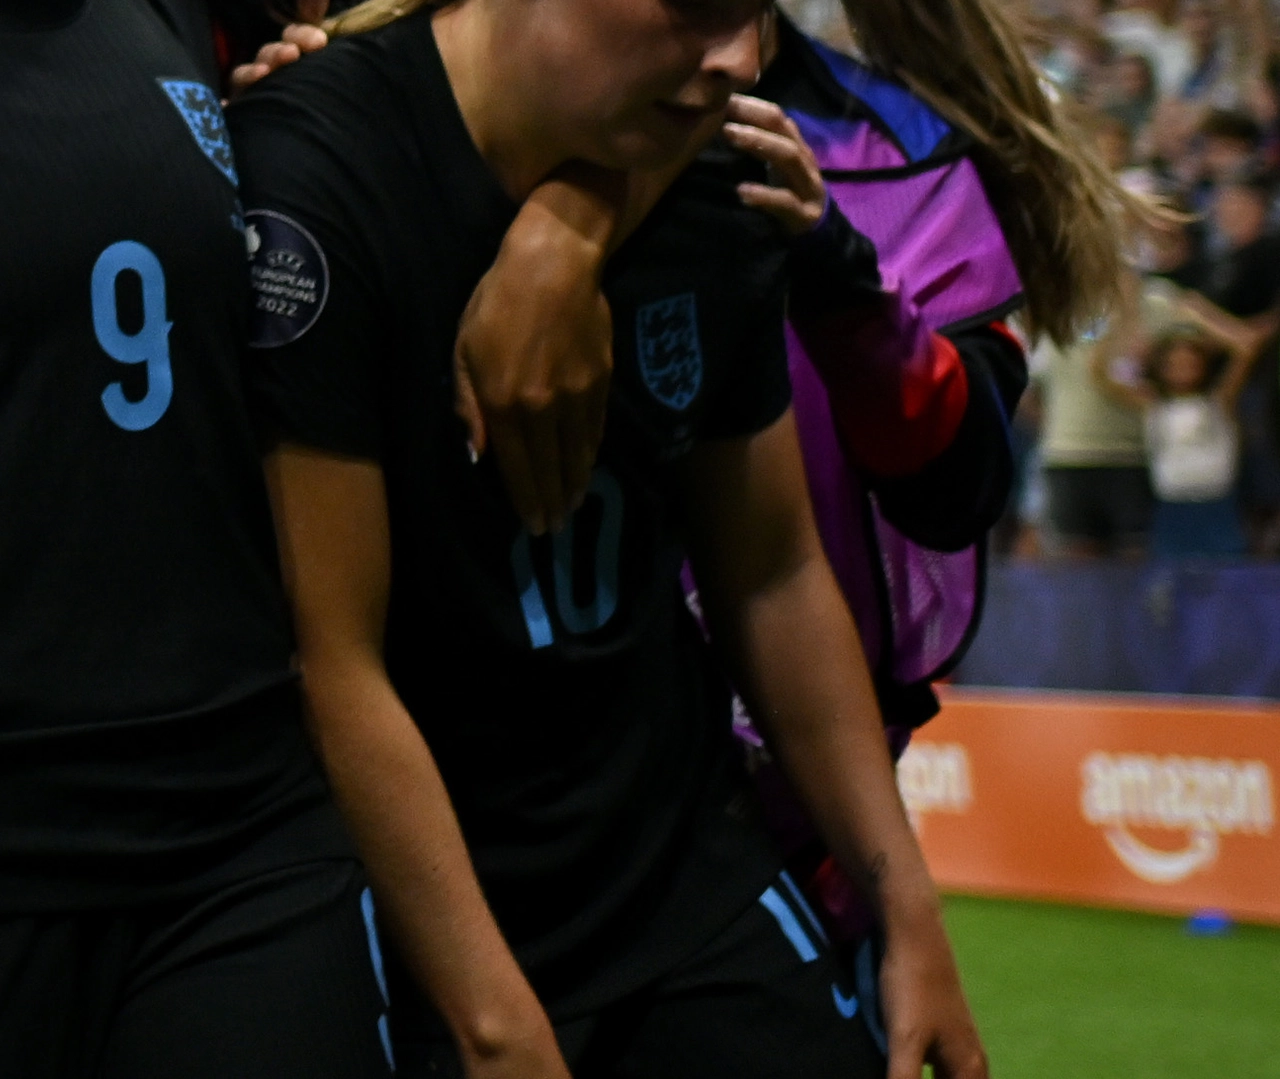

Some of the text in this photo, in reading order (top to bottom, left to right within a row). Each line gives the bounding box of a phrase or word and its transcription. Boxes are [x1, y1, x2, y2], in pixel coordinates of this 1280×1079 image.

[91, 240, 173, 431] 9
[256, 295, 297, 317] 2022
[511, 468, 624, 649] 10
[1081, 751, 1272, 835] amazon
